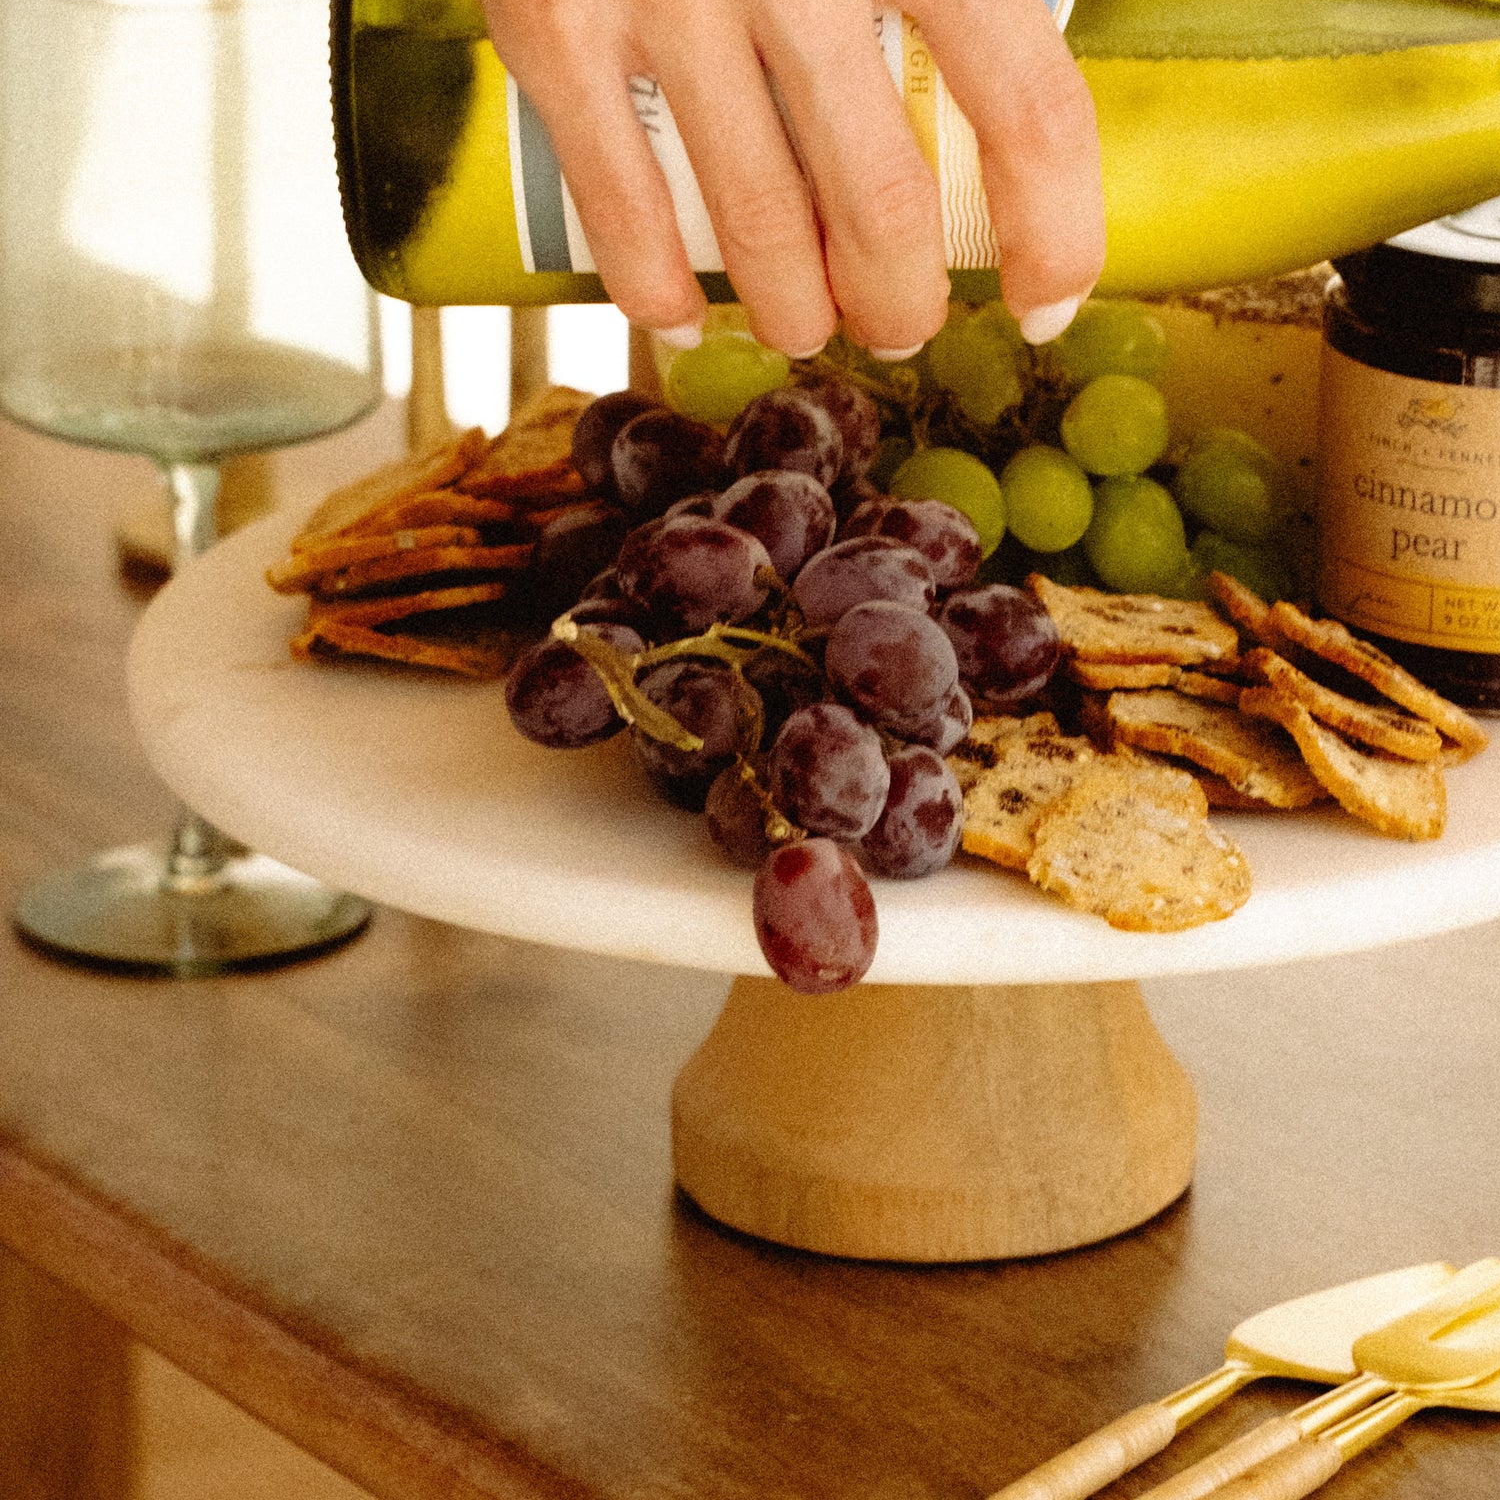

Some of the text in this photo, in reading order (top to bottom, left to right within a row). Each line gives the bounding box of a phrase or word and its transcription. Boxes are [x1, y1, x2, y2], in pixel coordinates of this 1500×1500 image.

[1391, 527, 1467, 561] pear
[1444, 596, 1475, 611] NET
[1444, 614, 1453, 627] 9
